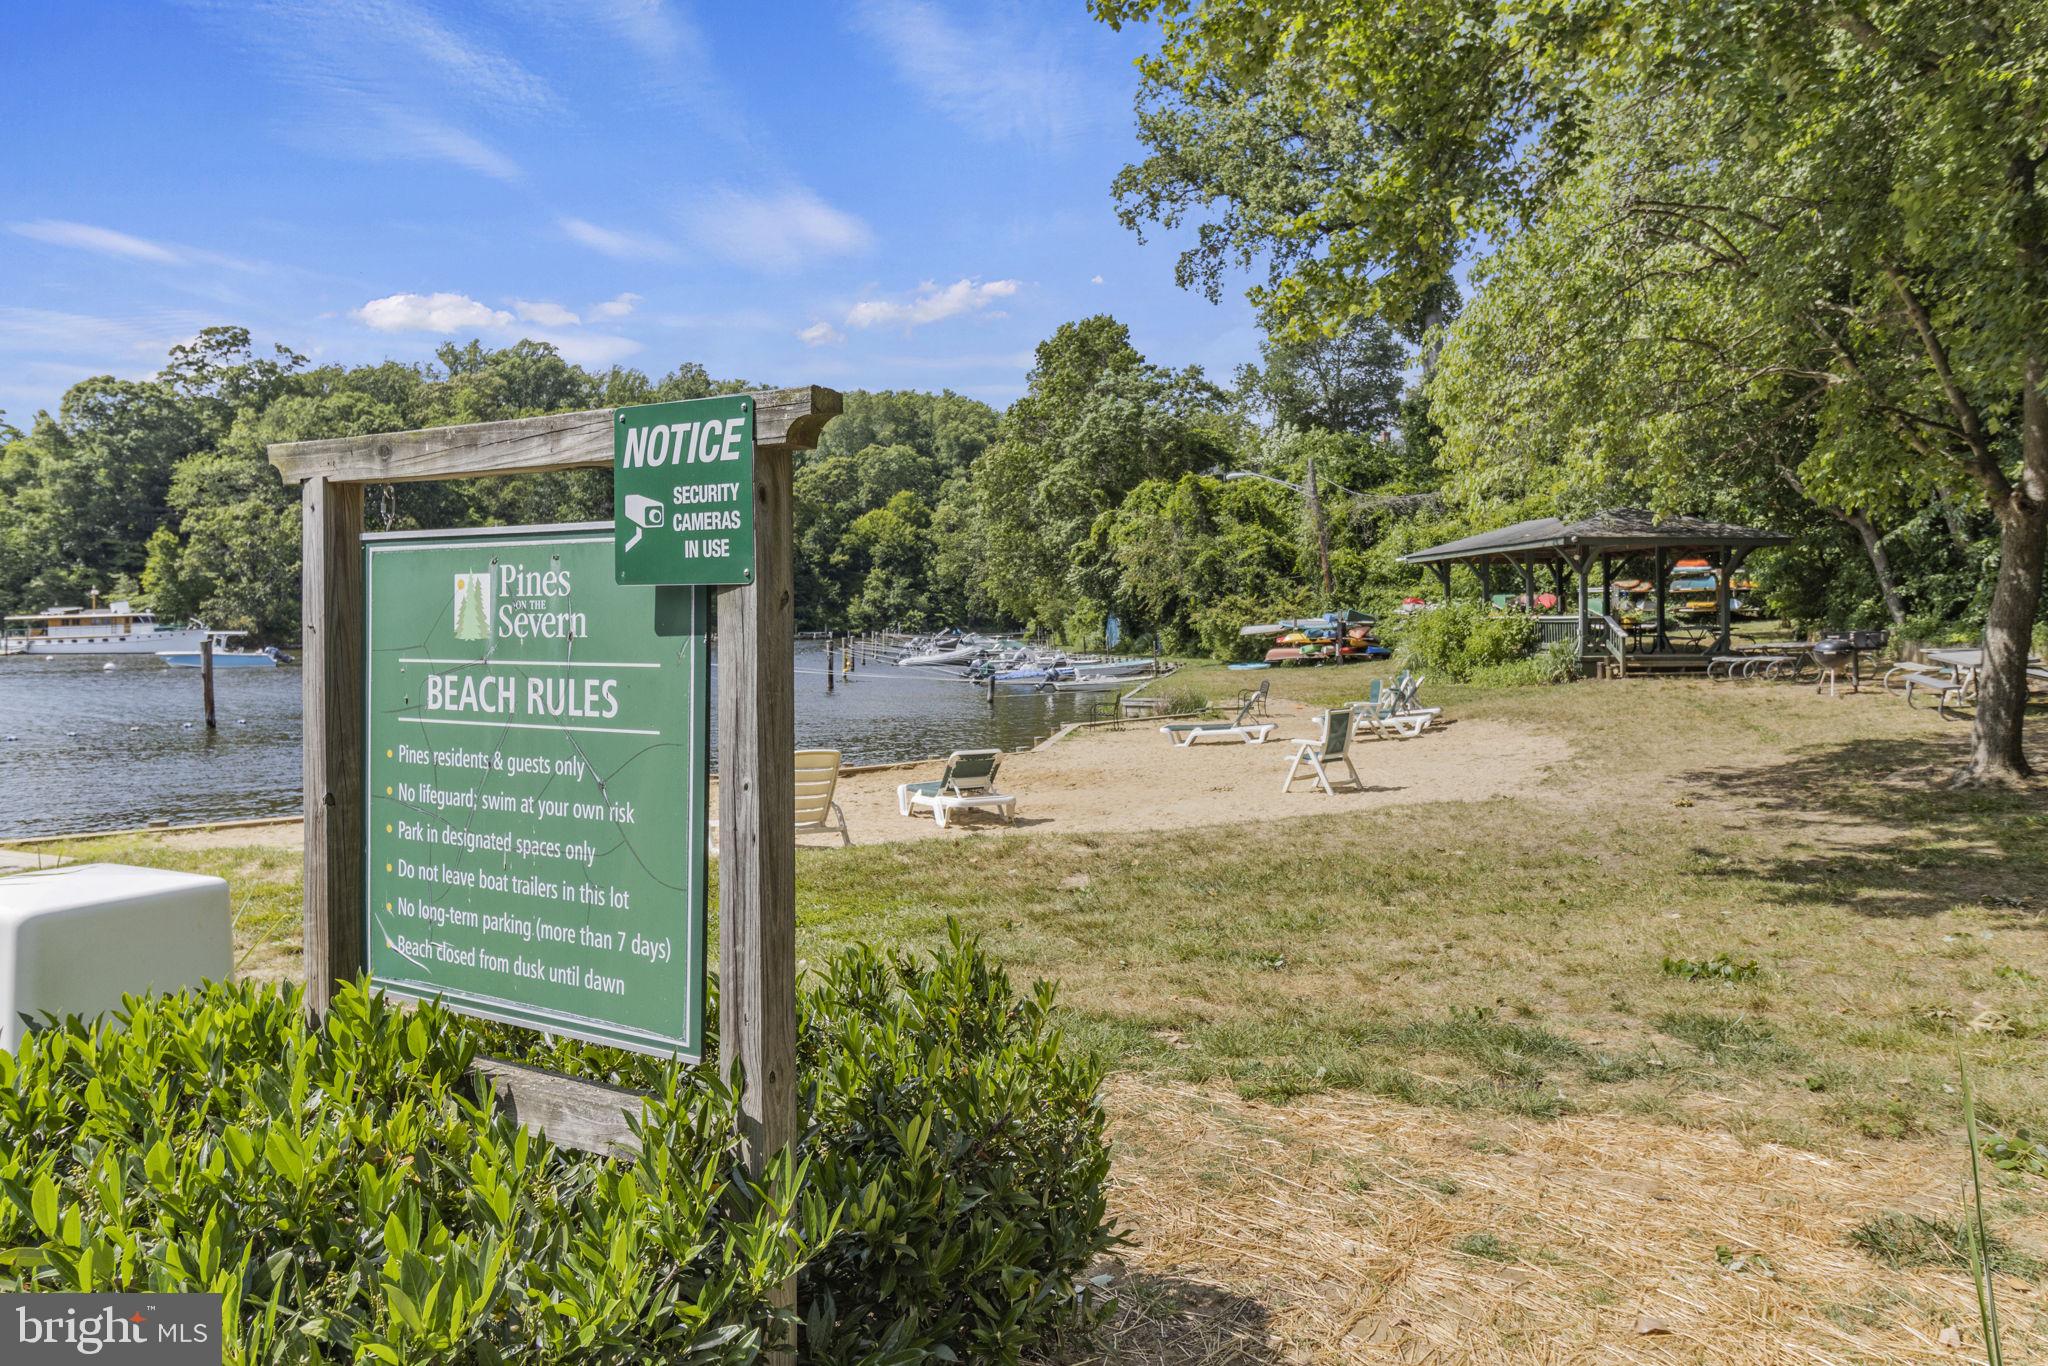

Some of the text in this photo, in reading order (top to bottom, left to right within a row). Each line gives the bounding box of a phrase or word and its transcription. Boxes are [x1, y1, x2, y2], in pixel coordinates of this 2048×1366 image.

[622, 417, 746, 469] NOTICE
[673, 482, 740, 505] SECURITY
[672, 510, 742, 532] CAMERAS
[684, 538, 730, 559] IN USE
[499, 563, 571, 597] Pines
[498, 604, 588, 639] Severn
[513, 600, 546, 610] ON THE
[427, 674, 619, 719] BEACH RULES
[398, 744, 585, 782] Pines residents & guests only
[398, 782, 415, 801] No
[481, 791, 516, 812] swim
[520, 796, 534, 814] at
[538, 800, 569, 820] your
[573, 802, 604, 820] own
[609, 802, 635, 824] risk
[398, 820, 596, 867] Park in designated spaces only
[398, 859, 630, 909] Do not leave boat trailers in this lot
[398, 897, 671, 963] No long-term parking (more than 7 days)
[398, 935, 625, 995] Beach closed from dusk until dawn
